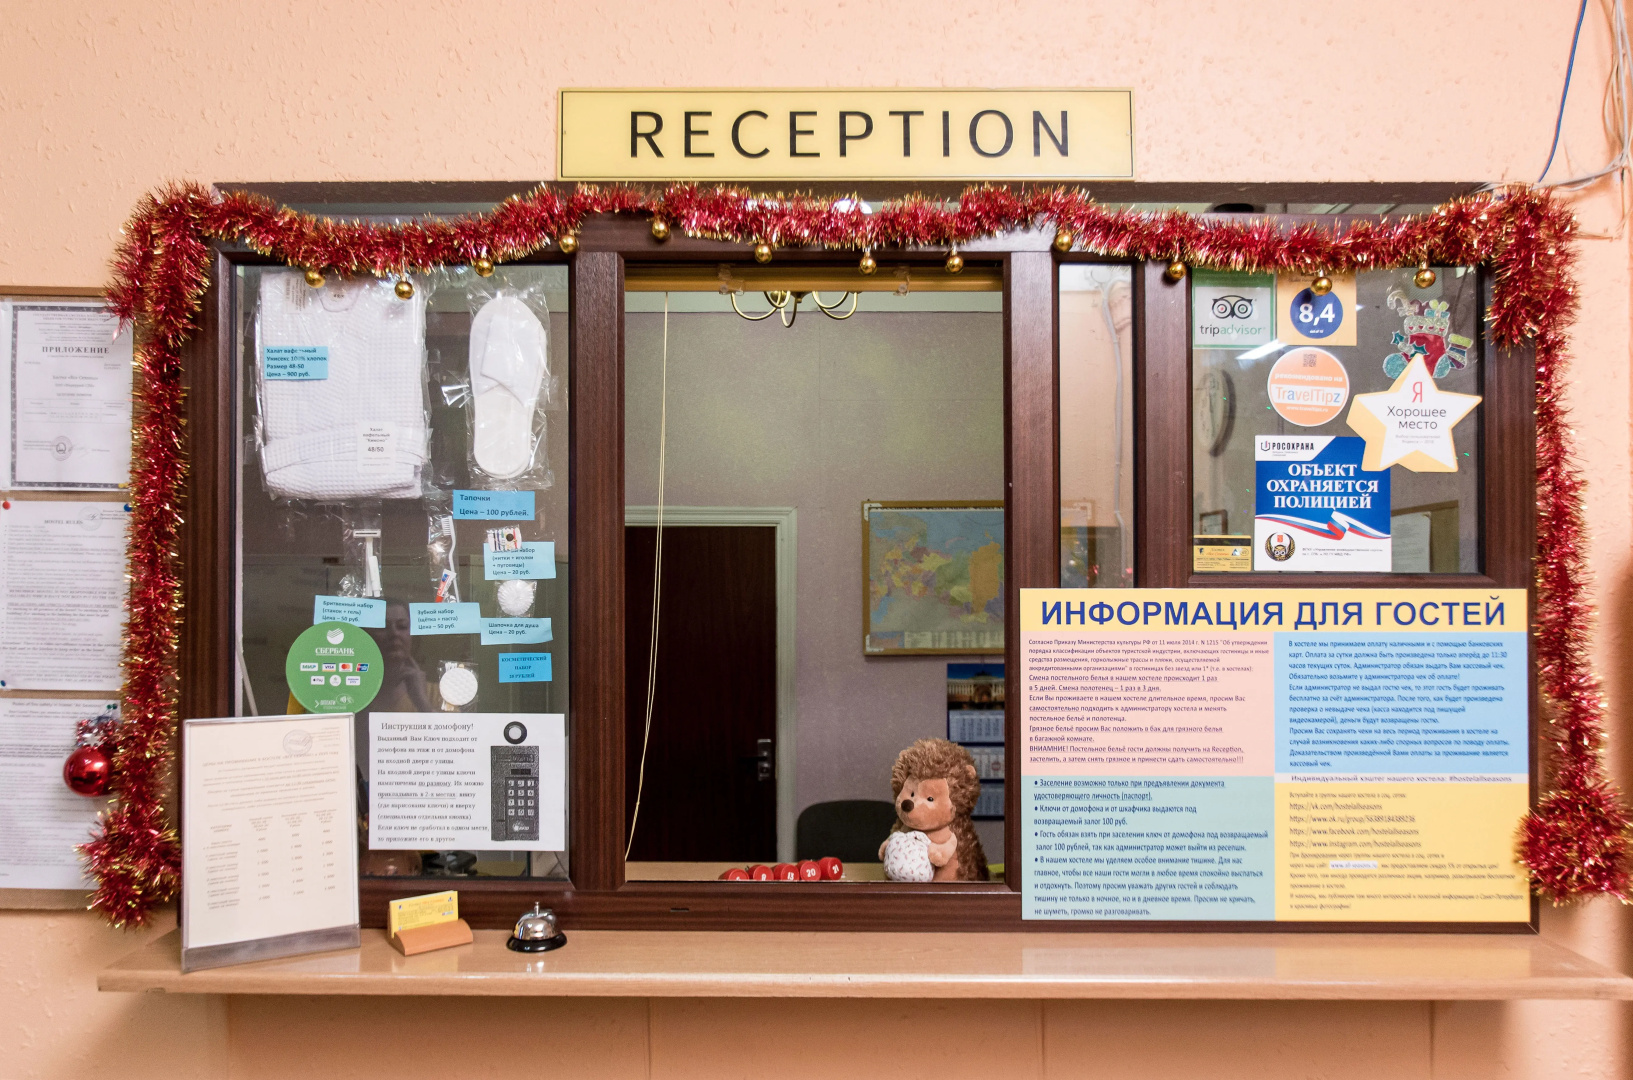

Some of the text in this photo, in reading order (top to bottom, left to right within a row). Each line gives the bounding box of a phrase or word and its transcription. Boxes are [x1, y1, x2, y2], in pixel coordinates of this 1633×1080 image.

[630, 110, 1069, 159] RECEPTION
[1299, 303, 1335, 326] 8,4
[1200, 324, 1263, 337] tripadvisor
[42, 346, 109, 354] ПРИЛОЖЕНИЕ
[1276, 386, 1340, 406] TravelTipz
[1412, 382, 1422, 403] Я
[1387, 406, 1446, 419] Хорошее
[1398, 420, 1438, 430] место
[1272, 442, 1315, 450] РОСОХРАНА
[1288, 463, 1357, 477] ОБЪЕКТ
[1266, 479, 1379, 493] ОХРАНЯЕТСЯ
[1273, 494, 1372, 510] ПОЛИЦИЕЙ
[501, 509, 529, 517] рублей.
[1042, 596, 1504, 630] ИНФОРМАЦИЯ ДЛЯ ГОСТЕЙ
[381, 723, 426, 731] Инструкция
[434, 722, 474, 732] домофону!
[1070, 804, 1104, 814] домофона
[1118, 804, 1150, 814] шкафчика
[1034, 816, 1082, 826] возвращаемый
[1114, 818, 1128, 826] руб.
[1057, 830, 1080, 838] обязан
[1172, 830, 1205, 840] домофона
[1220, 830, 1268, 840] возвращаемый
[1054, 843, 1065, 851] 100
[1066, 843, 1090, 852] рублей,
[1116, 844, 1164, 852] администратор
[806, 868, 816, 878] 20
